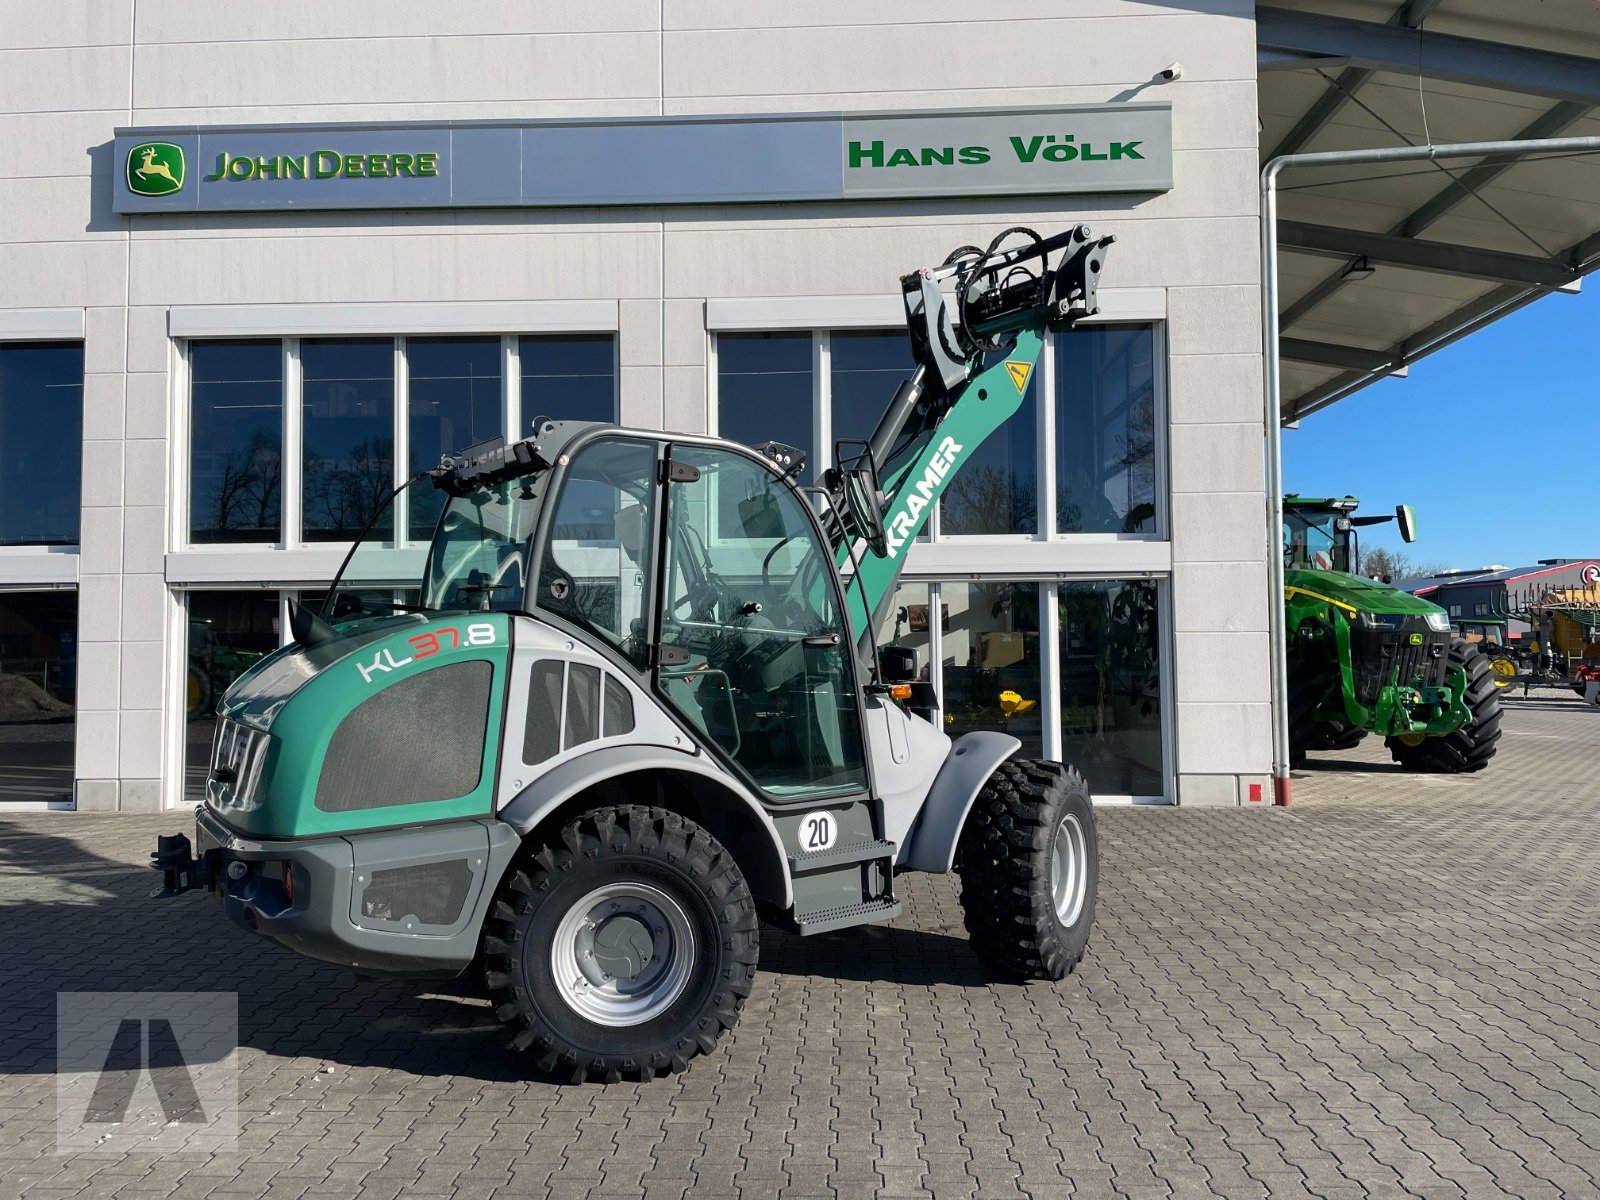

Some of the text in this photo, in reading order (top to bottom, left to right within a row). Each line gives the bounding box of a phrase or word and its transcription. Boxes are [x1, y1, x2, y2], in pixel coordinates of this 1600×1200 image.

[207, 149, 439, 180] JOHN DEERE
[848, 134, 1145, 168] HANS VÖLK
[886, 436, 963, 559] KRAMER
[356, 623, 496, 684] KL37.8
[808, 817, 829, 848] 20
